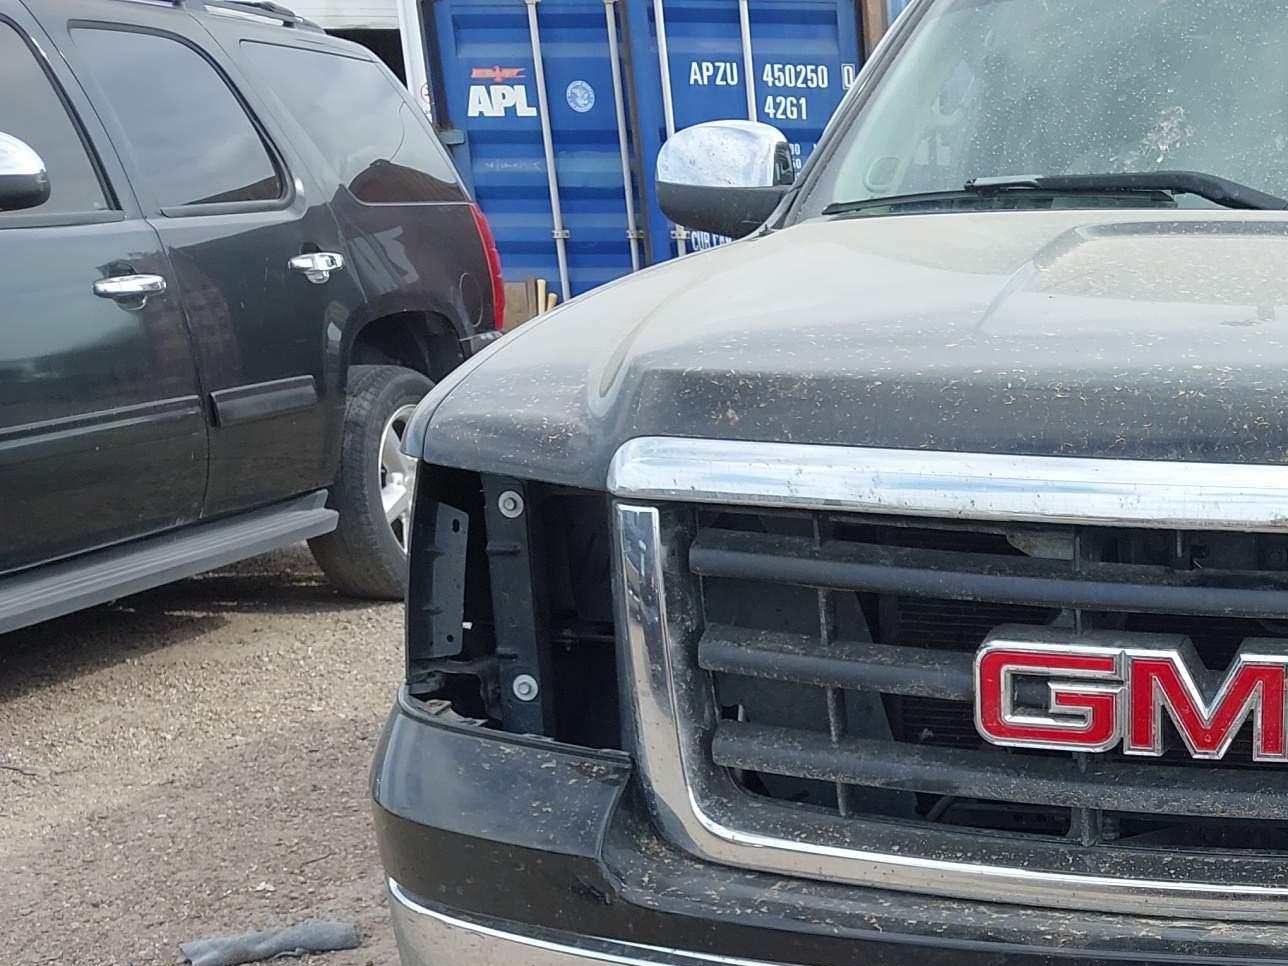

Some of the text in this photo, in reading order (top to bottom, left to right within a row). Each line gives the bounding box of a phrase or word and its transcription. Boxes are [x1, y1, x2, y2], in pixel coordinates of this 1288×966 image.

[689, 61, 738, 86] APZU
[762, 63, 828, 88] 450250
[467, 85, 537, 117] APL
[764, 95, 807, 120] 42G1
